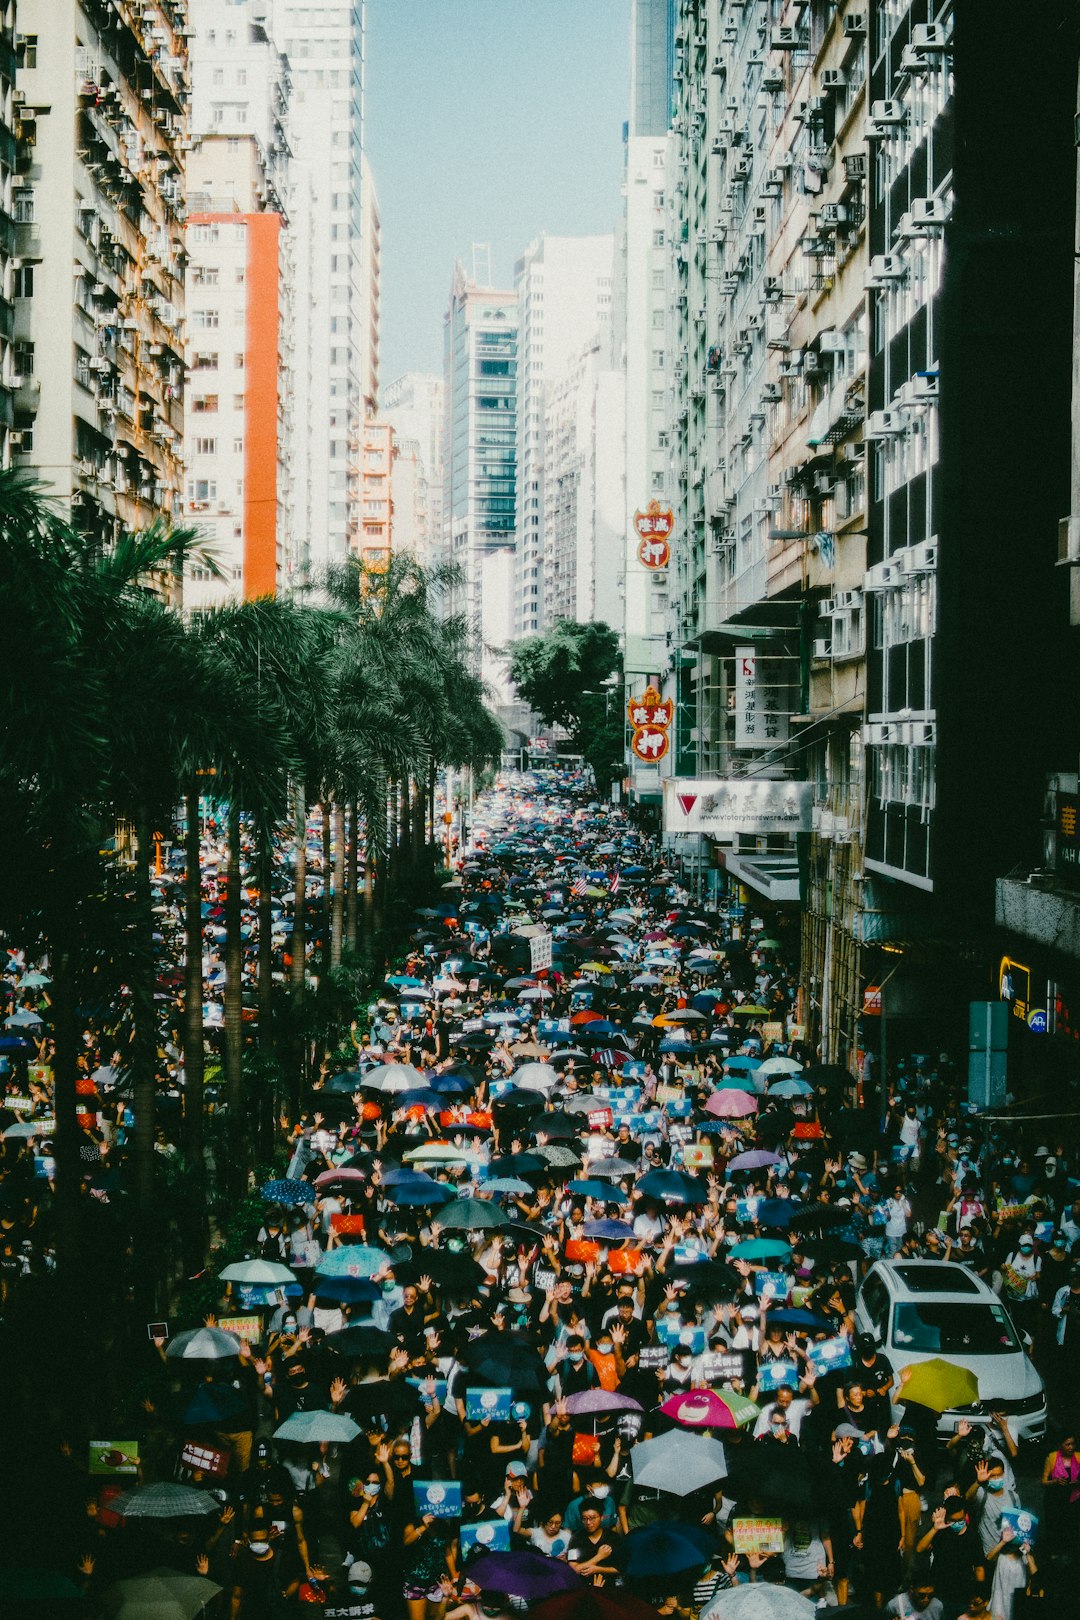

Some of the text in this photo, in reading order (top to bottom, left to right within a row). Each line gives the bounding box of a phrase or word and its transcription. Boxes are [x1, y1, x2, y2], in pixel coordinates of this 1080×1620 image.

[641, 540, 665, 566] 押
[637, 729, 664, 757] 押
[324, 1603, 375, 1618] 五大訴求
